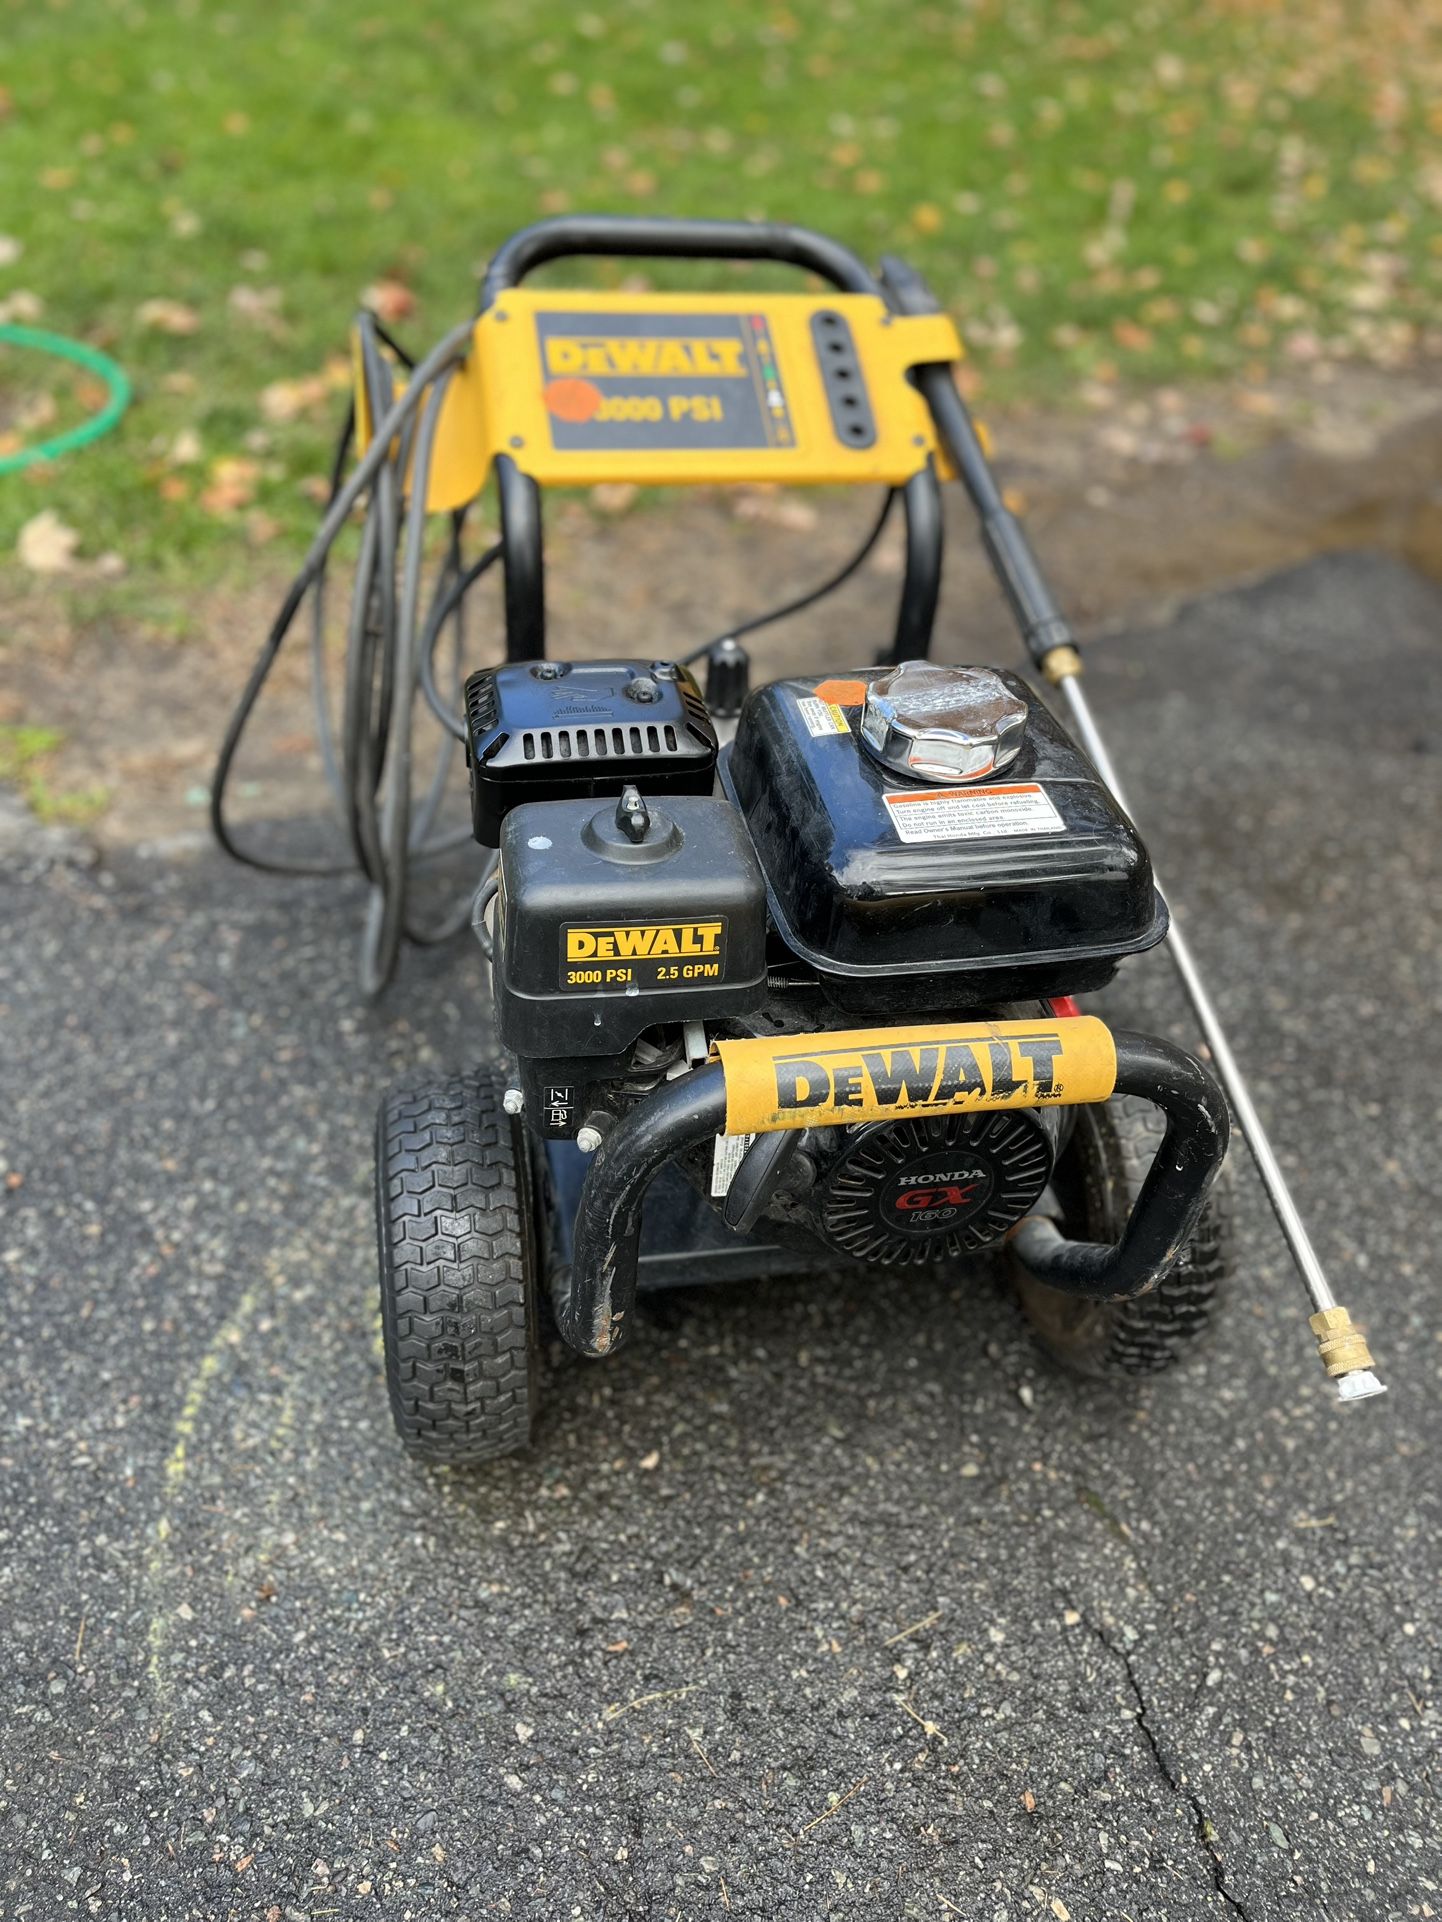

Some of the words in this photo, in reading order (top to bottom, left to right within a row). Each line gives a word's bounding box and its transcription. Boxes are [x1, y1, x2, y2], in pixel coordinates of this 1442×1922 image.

[668, 395, 724, 422] PSI
[949, 788, 992, 798] WARNING
[567, 926, 722, 958] DEWALT
[567, 970, 602, 984] 3000
[606, 968, 632, 982] PSI
[657, 966, 679, 980] 2.5
[682, 963, 719, 978] GPM
[773, 1040, 1064, 1110] DEWALT
[898, 1169, 987, 1186] HONDA
[895, 1183, 981, 1210] GX
[909, 1207, 958, 1223] 160
